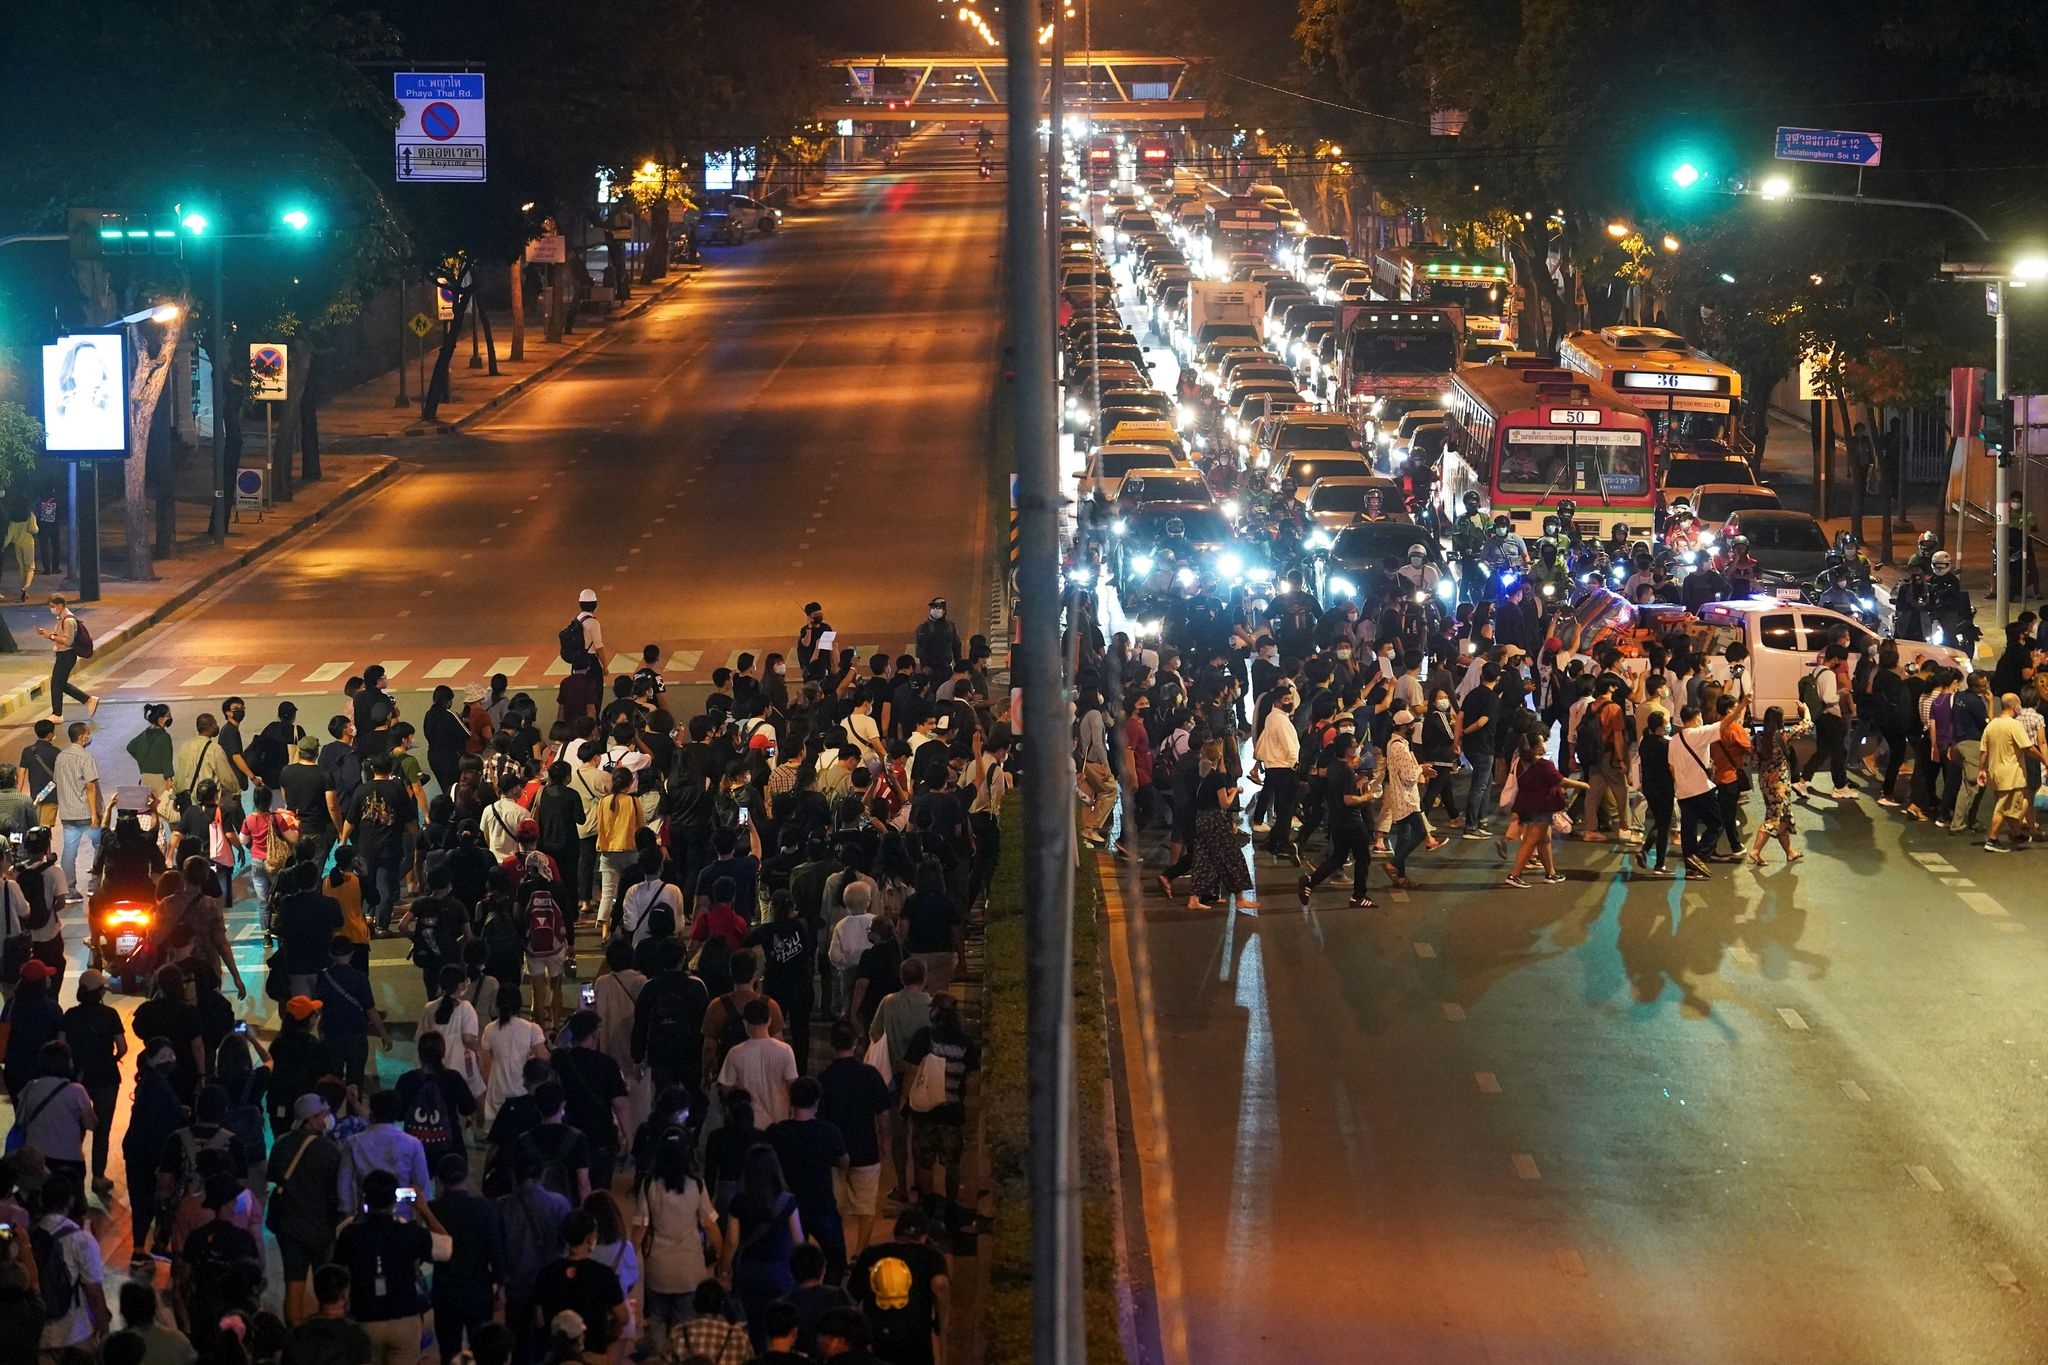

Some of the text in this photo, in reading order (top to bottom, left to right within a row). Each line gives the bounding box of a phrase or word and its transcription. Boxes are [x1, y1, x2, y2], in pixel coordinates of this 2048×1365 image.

[430, 75, 461, 90] พญาไท
[406, 89, 473, 99] Phaya Thai Rd.
[1850, 139, 1860, 149] 12
[418, 147, 479, 159] ตลอดเวลา
[1782, 147, 1834, 159] Chulalongkorn
[1837, 152, 1849, 160] Soi
[431, 159, 467, 168] Anytime
[1657, 373, 1678, 387] 36
[1566, 411, 1585, 424] 50
[1997, 514, 2002, 523] 3
